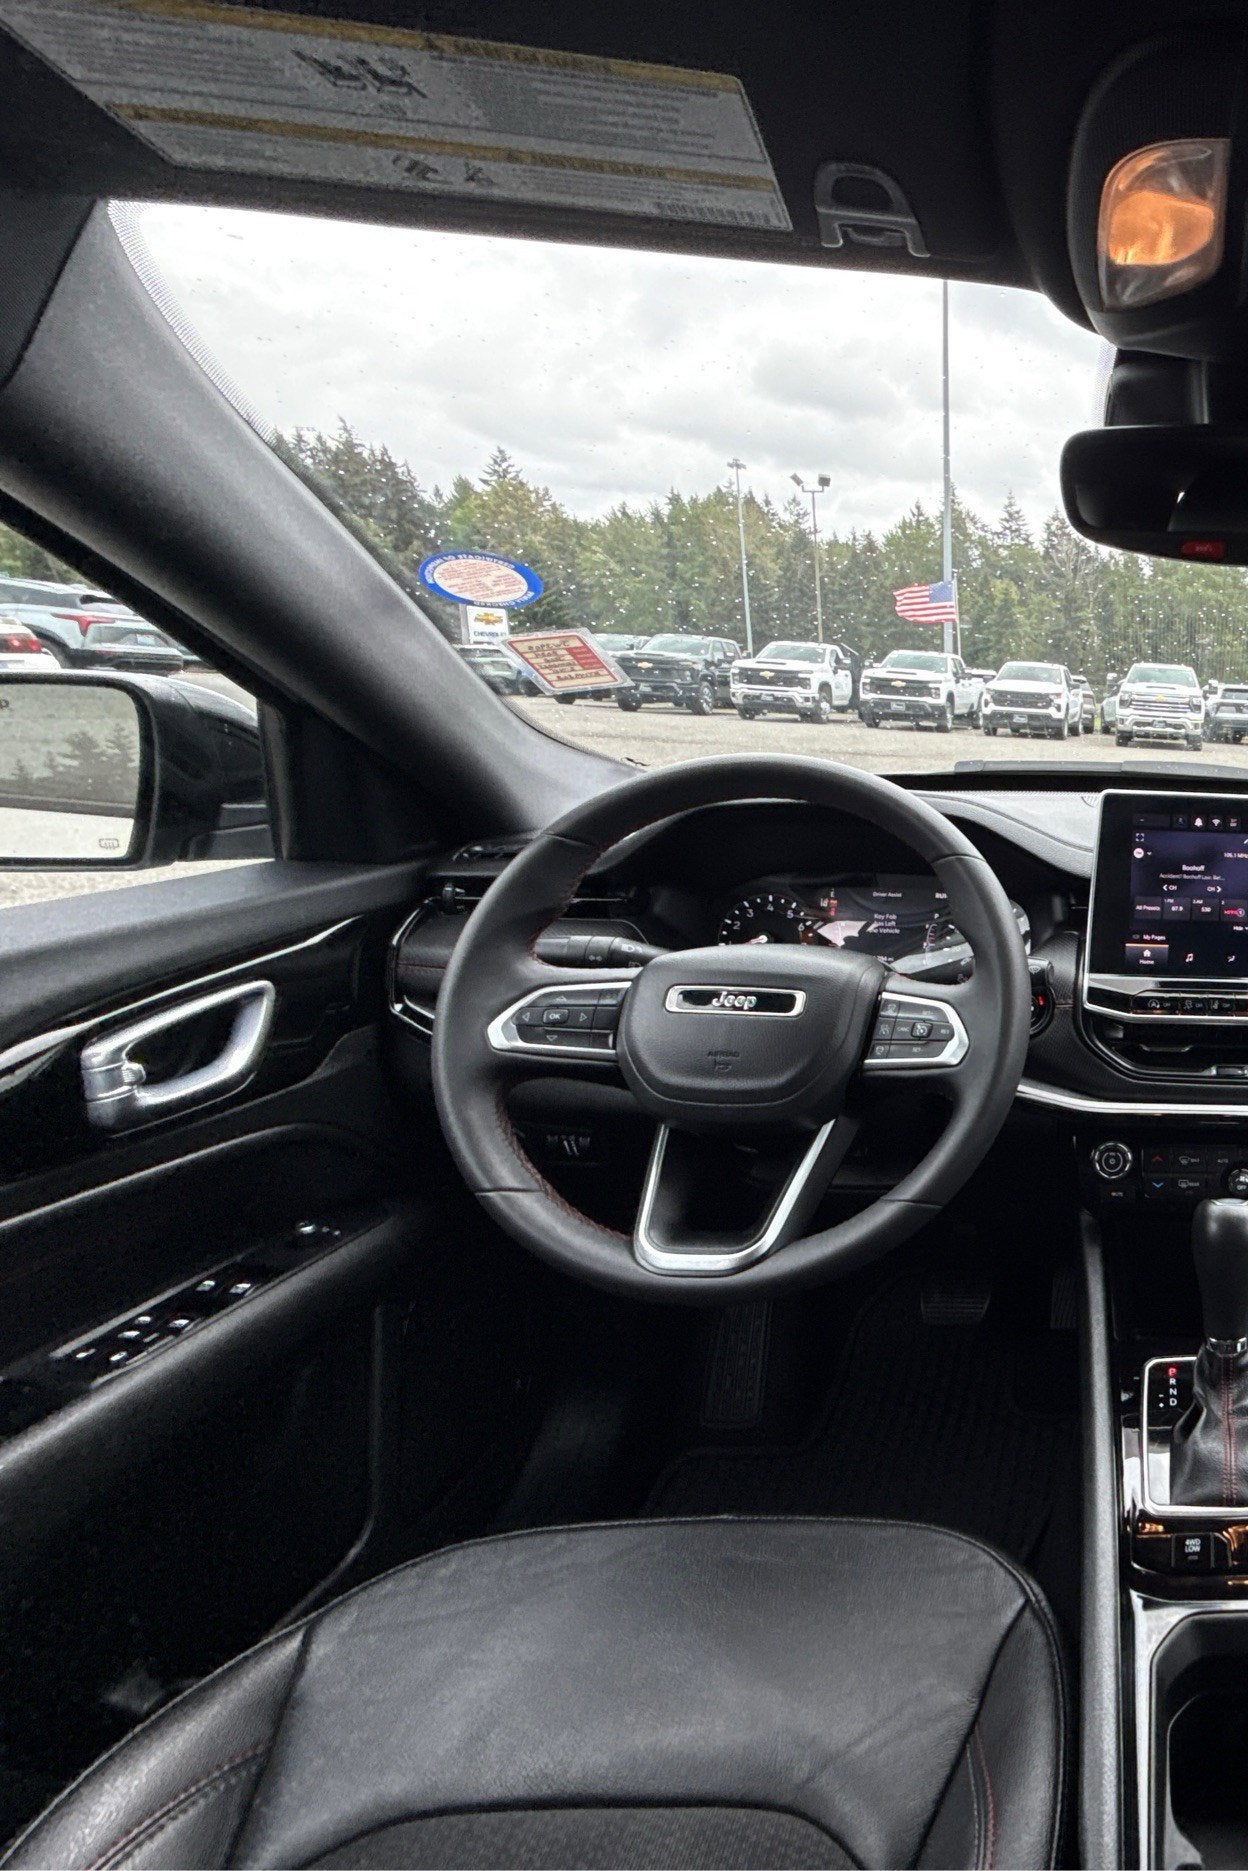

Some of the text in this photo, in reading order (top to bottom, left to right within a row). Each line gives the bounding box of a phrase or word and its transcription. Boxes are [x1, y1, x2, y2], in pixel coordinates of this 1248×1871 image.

[767, 904, 775, 912] 4
[746, 909, 754, 918] 3
[786, 909, 794, 919] 5
[733, 921, 741, 930] 2
[798, 922, 805, 931] 6
[711, 990, 758, 1011] Jeep
[1168, 1367, 1177, 1377] P
[1169, 1378, 1177, 1386] R
[1169, 1388, 1178, 1396] N
[1169, 1398, 1178, 1407] D
[1185, 1538, 1201, 1546] 4WD
[1184, 1545, 1201, 1553] LOW
